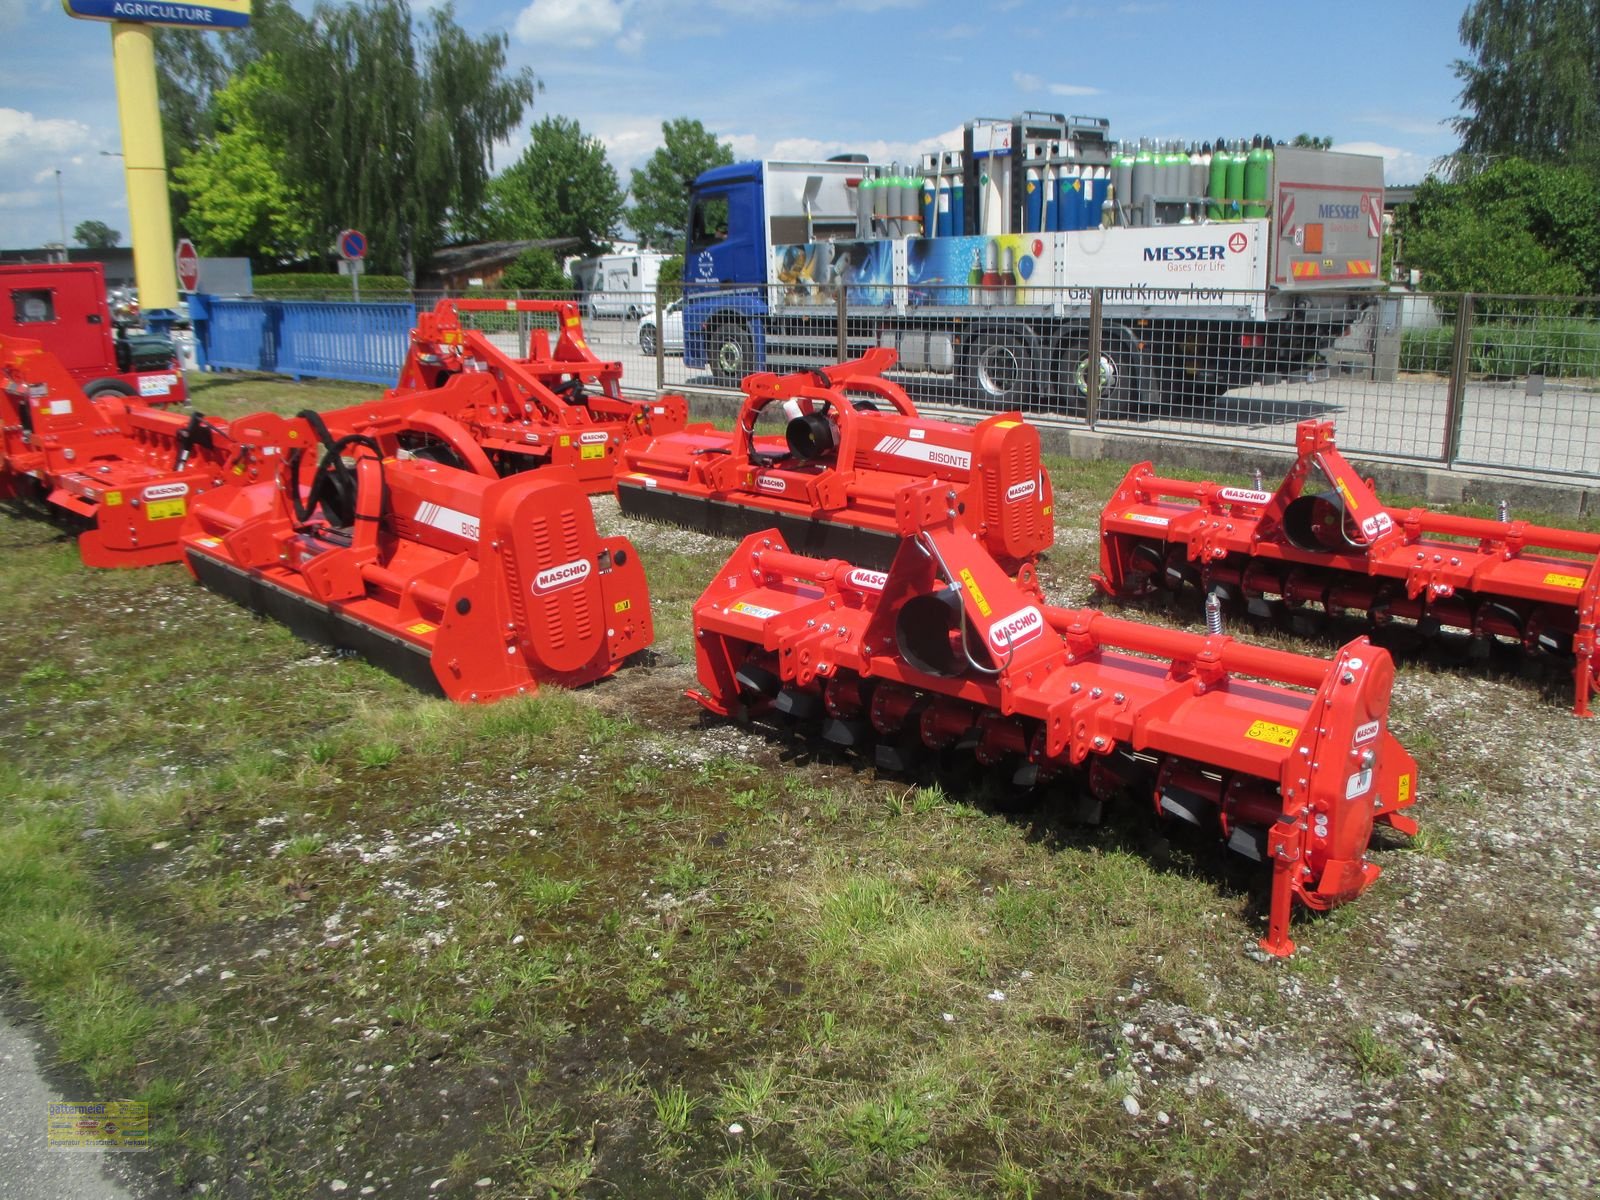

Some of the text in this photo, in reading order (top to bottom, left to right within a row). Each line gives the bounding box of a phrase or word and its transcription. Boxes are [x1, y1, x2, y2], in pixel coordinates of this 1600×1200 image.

[113, 3, 213, 22] AGRICULTURE
[1319, 204, 1359, 219] MESSER
[1143, 246, 1225, 261] MESSER
[1167, 261, 1225, 272] Gases for Life
[929, 451, 968, 468] BISONTE
[759, 478, 784, 488] MASCHIO
[1010, 483, 1033, 496] MASCHIO
[1225, 489, 1266, 501] MASCHIO
[539, 563, 587, 585] MASCHIO
[994, 612, 1037, 642] MASCHIO
[1357, 725, 1377, 739] MASCHIO
